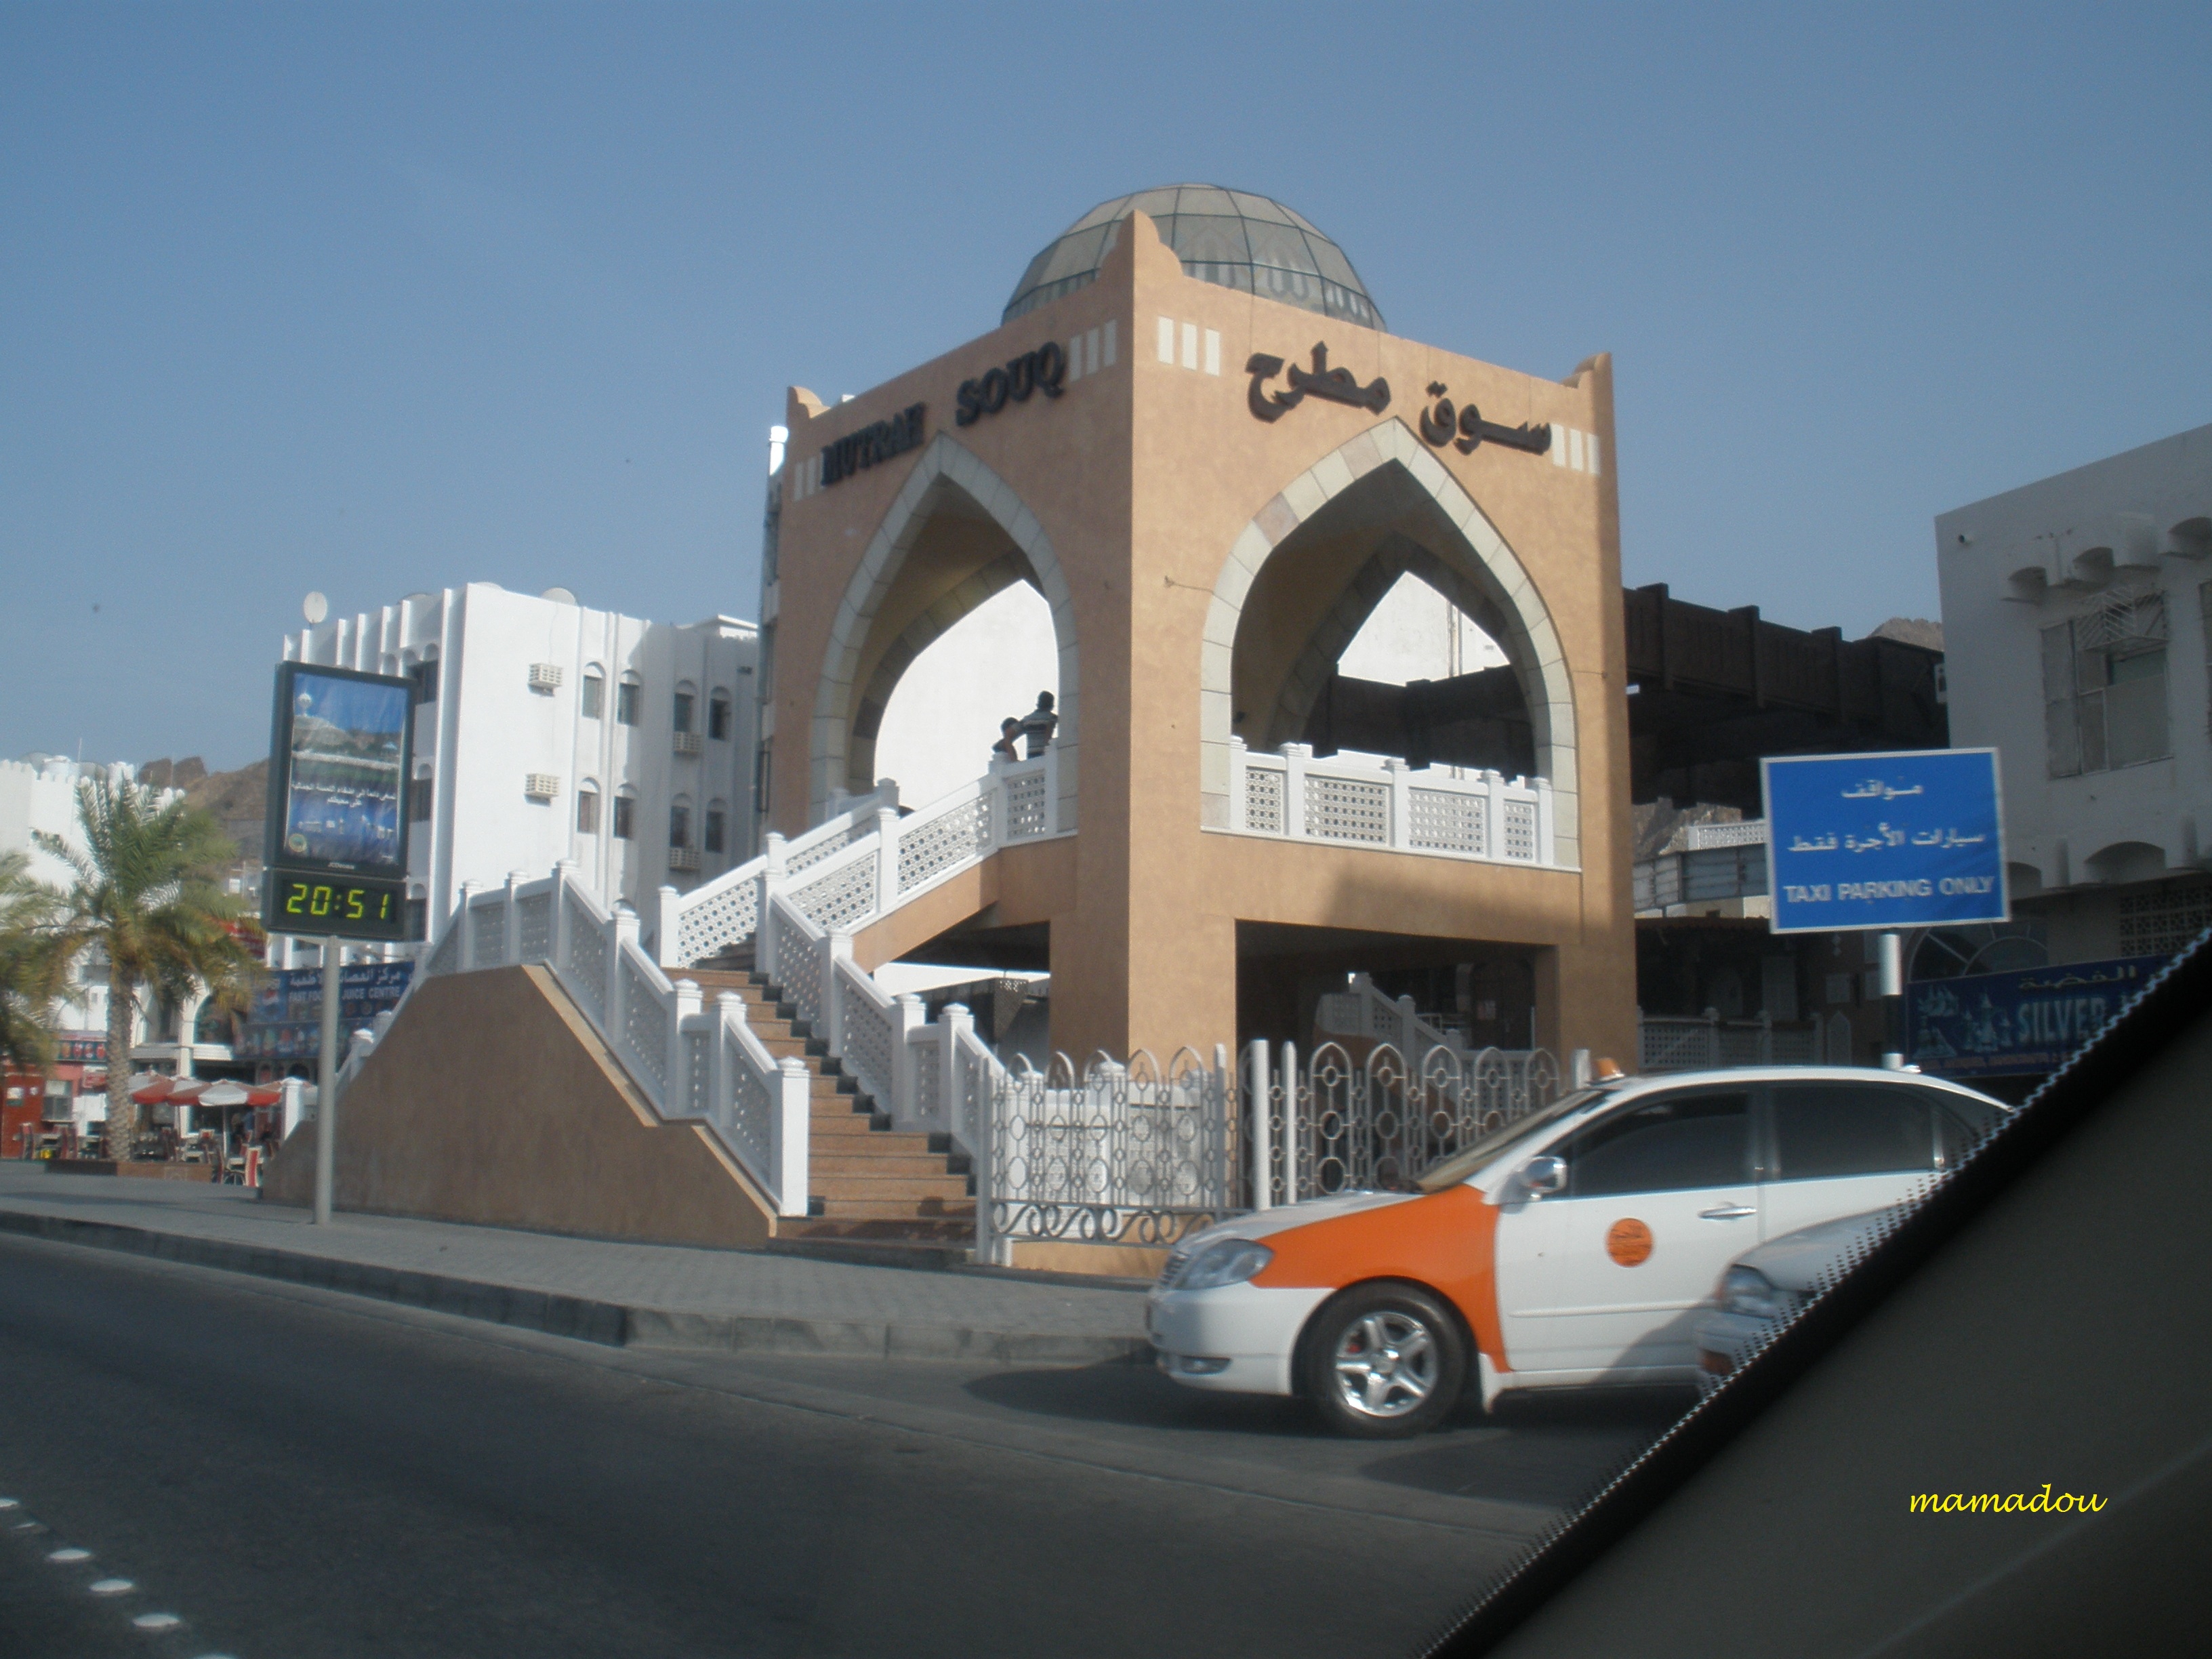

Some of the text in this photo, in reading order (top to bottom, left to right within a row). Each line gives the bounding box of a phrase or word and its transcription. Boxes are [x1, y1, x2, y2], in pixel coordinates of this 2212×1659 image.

[1245, 340, 1552, 455] سوق مطرح
[820, 341, 1065, 487] MUTRAH SOUQ
[1840, 778, 1924, 801] موقف
[1786, 821, 1984, 853] سيارات الأجرة فقط
[287, 884, 389, 919] 20:51
[1783, 875, 1994, 903] TAXI PARKING ONLY
[342, 987, 365, 1000] JUICE
[368, 985, 401, 999] CENTRE
